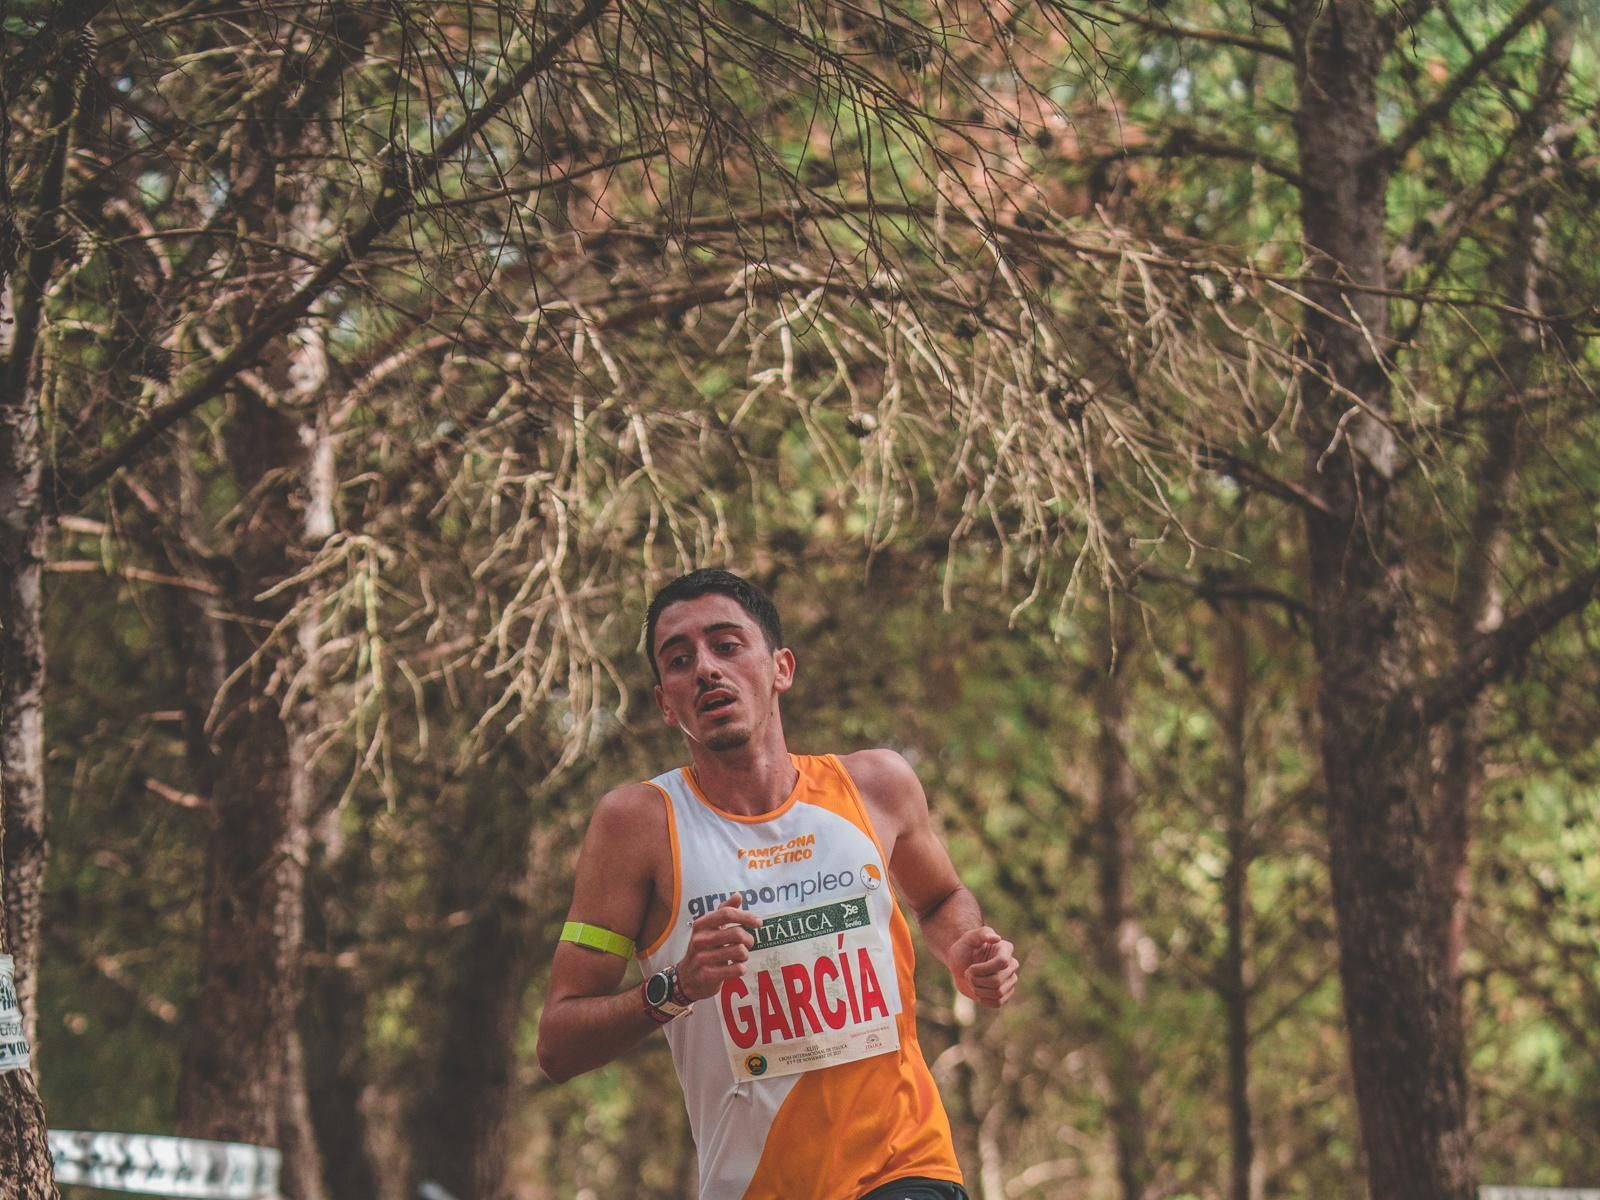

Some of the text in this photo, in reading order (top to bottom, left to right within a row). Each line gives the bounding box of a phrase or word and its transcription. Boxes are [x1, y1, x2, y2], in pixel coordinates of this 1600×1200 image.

[737, 833, 816, 859] PAMPLONA
[748, 848, 813, 870] ATLÉTICO
[753, 912, 834, 944] ITÁLICA
[720, 932, 890, 1050] GARCÍA
